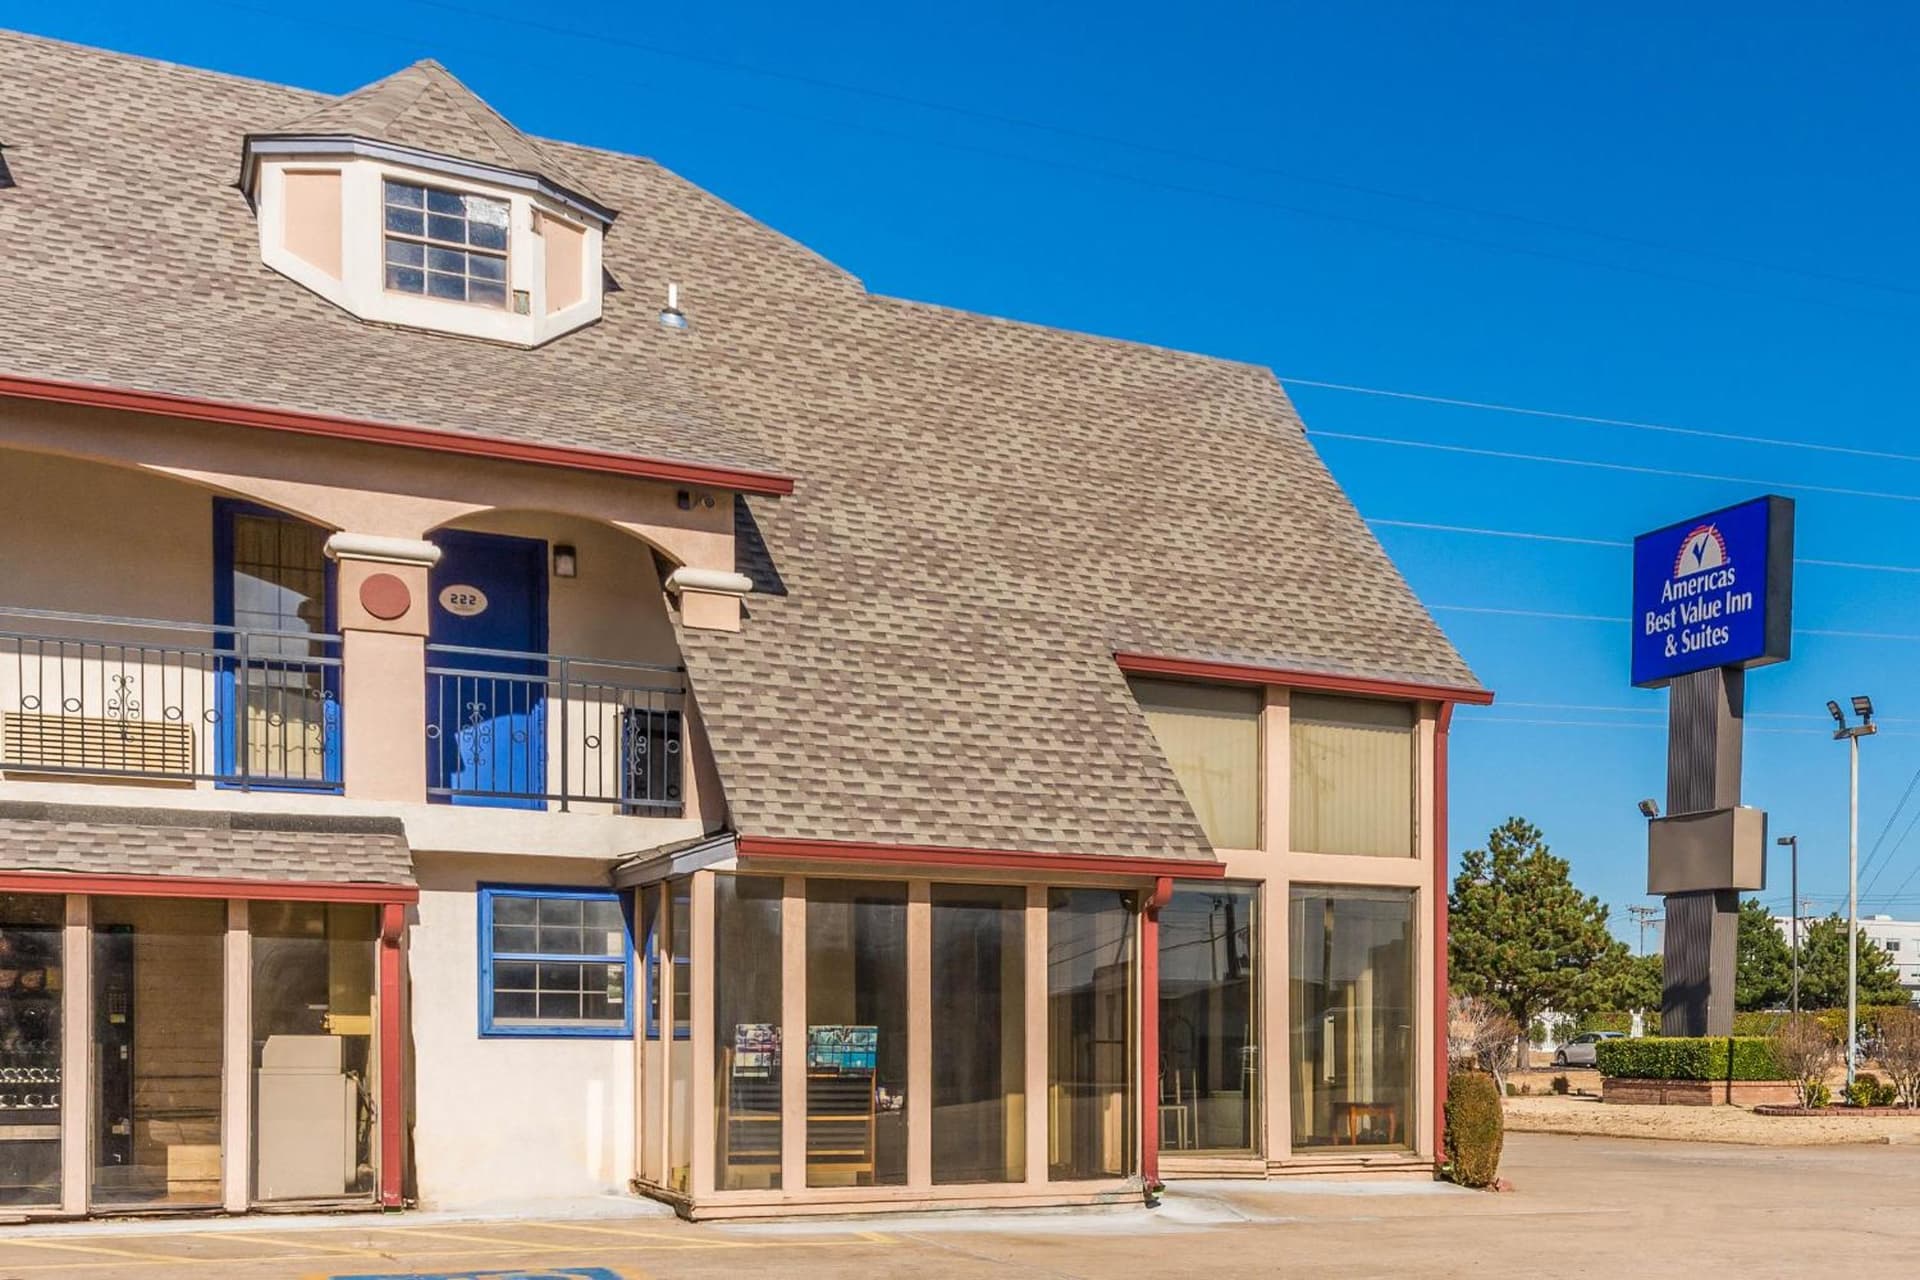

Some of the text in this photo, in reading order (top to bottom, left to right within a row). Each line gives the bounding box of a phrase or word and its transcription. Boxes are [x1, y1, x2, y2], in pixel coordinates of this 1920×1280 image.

[450, 593, 477, 606] 222
[1661, 567, 1736, 604] Americas
[1645, 590, 1753, 636] Best Value Inn
[1664, 625, 1730, 658] & Suites
